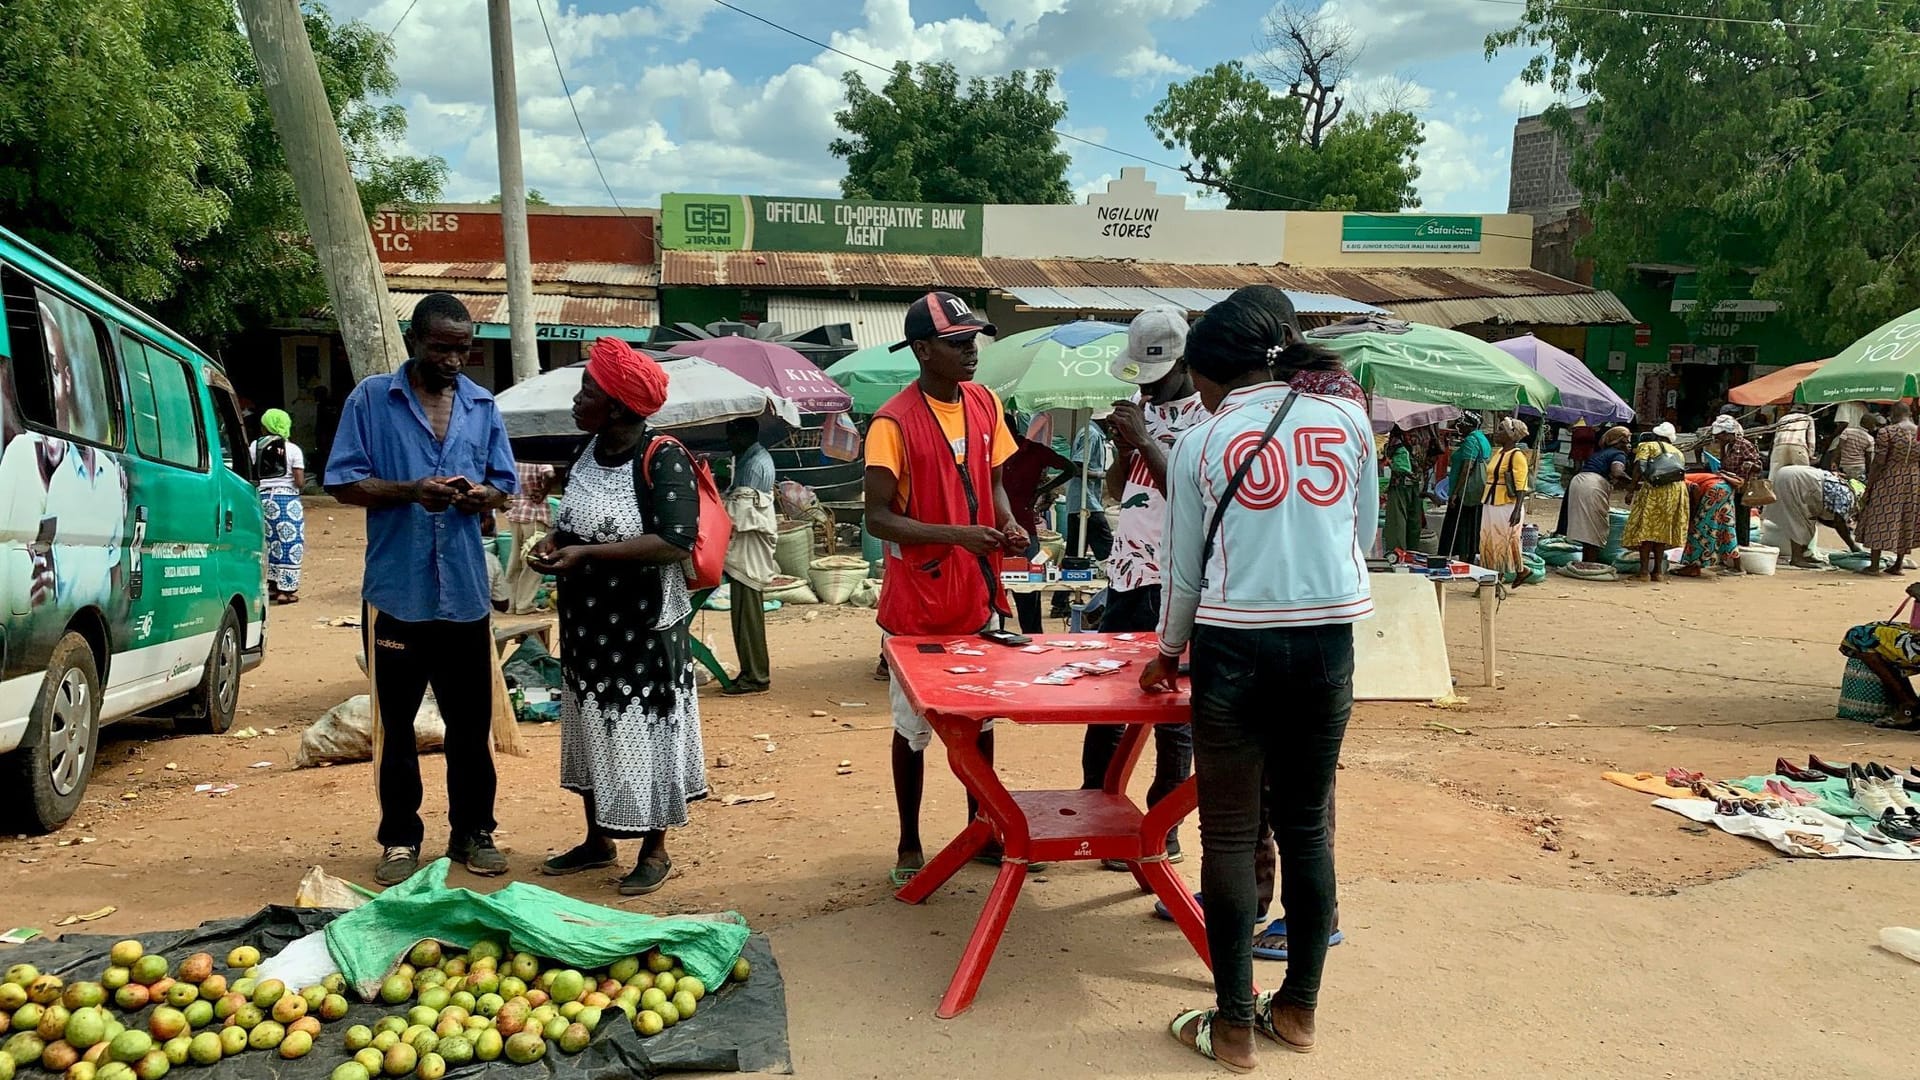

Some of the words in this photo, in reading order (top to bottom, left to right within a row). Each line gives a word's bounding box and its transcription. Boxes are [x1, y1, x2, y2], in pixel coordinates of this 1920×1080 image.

[766, 202, 825, 225] OFFICIAL
[835, 205, 923, 228] CO-OPERATIVE
[932, 209, 965, 230] BANK
[1098, 207, 1159, 221] NGILUNI
[372, 213, 459, 231] STORES
[846, 227, 887, 246] AGENT
[1102, 223, 1152, 238] STORES
[1427, 225, 1473, 235] Safaricom
[685, 235, 731, 245] JIRANI
[1702, 323, 1739, 336] SHOP
[1061, 345, 1120, 359] FOR
[1856, 341, 1920, 363] YOU
[1393, 384, 1416, 392] Simple
[1424, 387, 1464, 397] Transparent
[1223, 427, 1347, 510] 05
[376, 639, 404, 649] adidas
